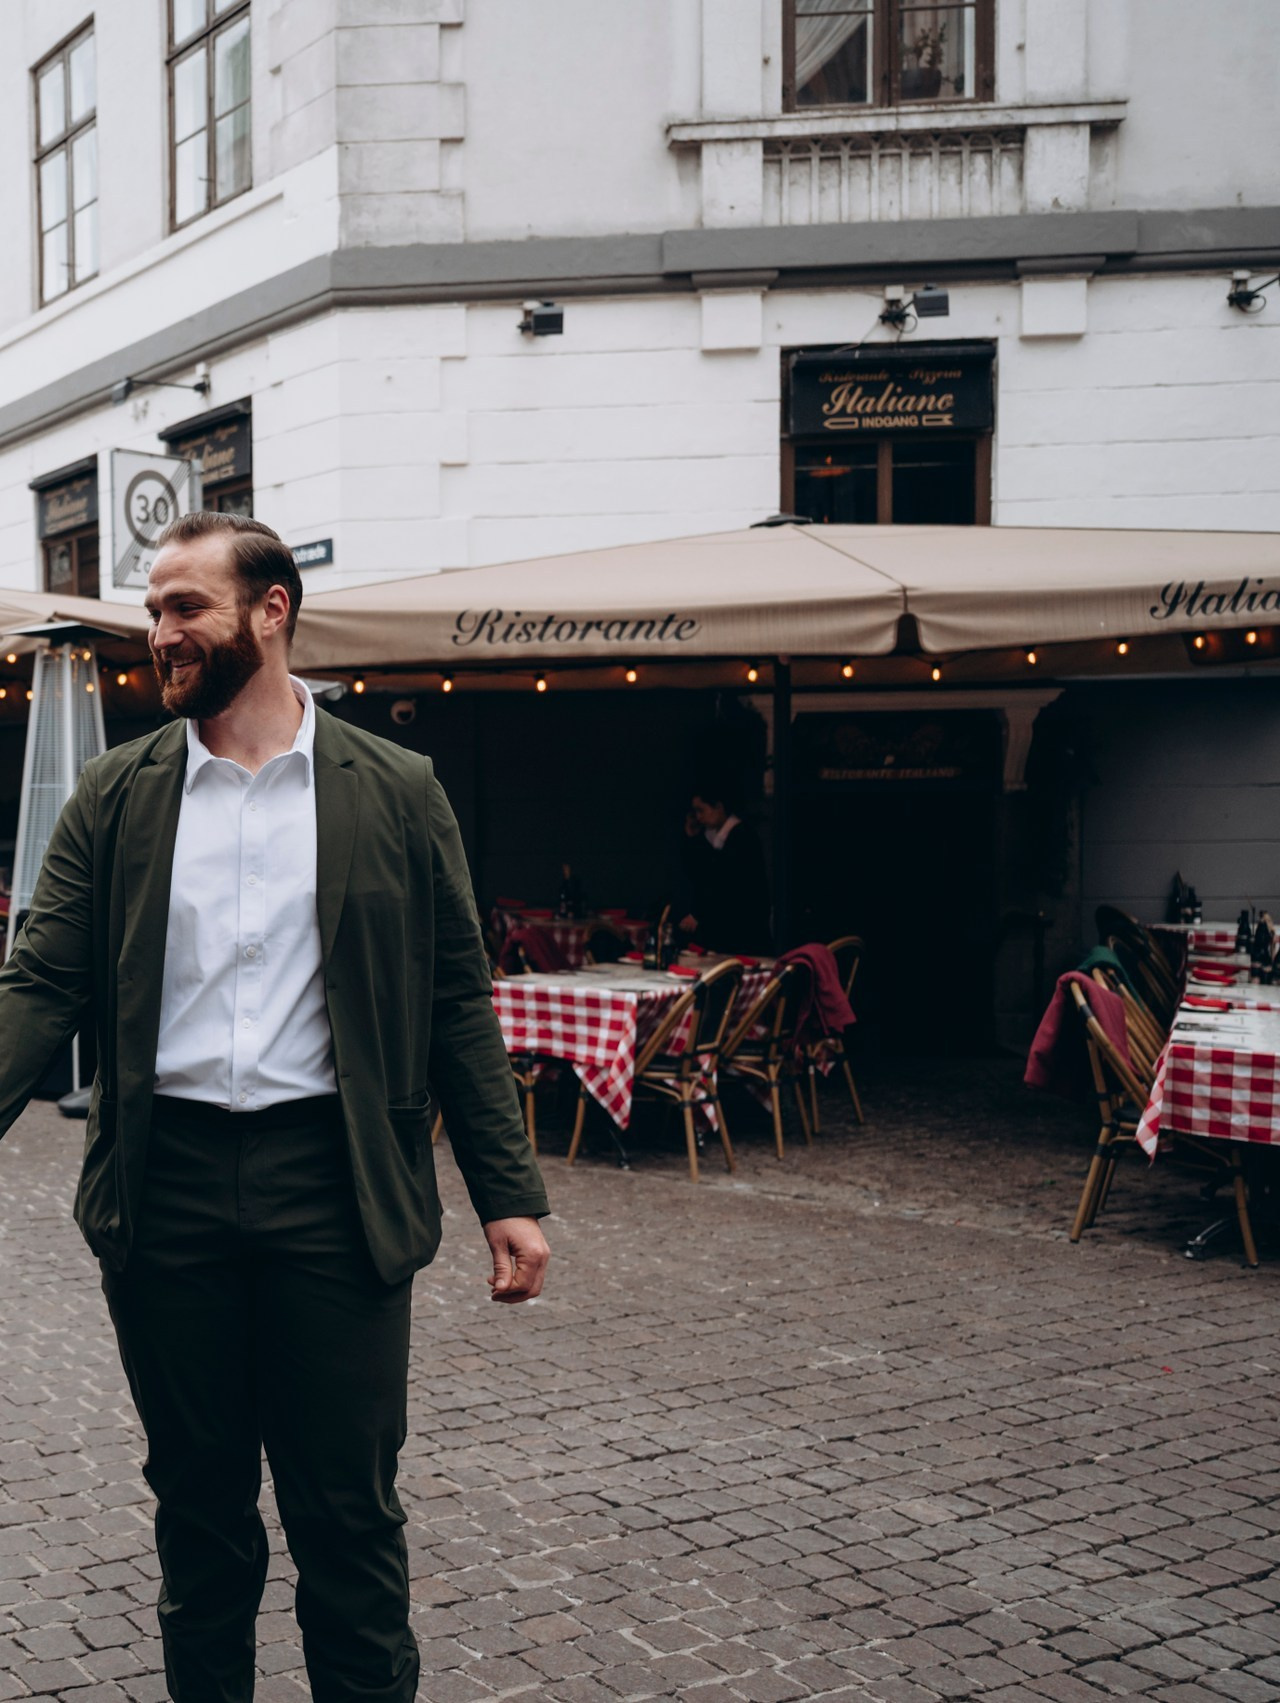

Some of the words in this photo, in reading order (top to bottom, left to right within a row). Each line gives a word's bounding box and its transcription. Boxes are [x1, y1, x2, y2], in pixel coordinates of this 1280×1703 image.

[822, 382, 955, 415] Italiano
[862, 415, 919, 428] INDGANG
[136, 494, 169, 525] 30
[452, 608, 703, 647] Ristorante
